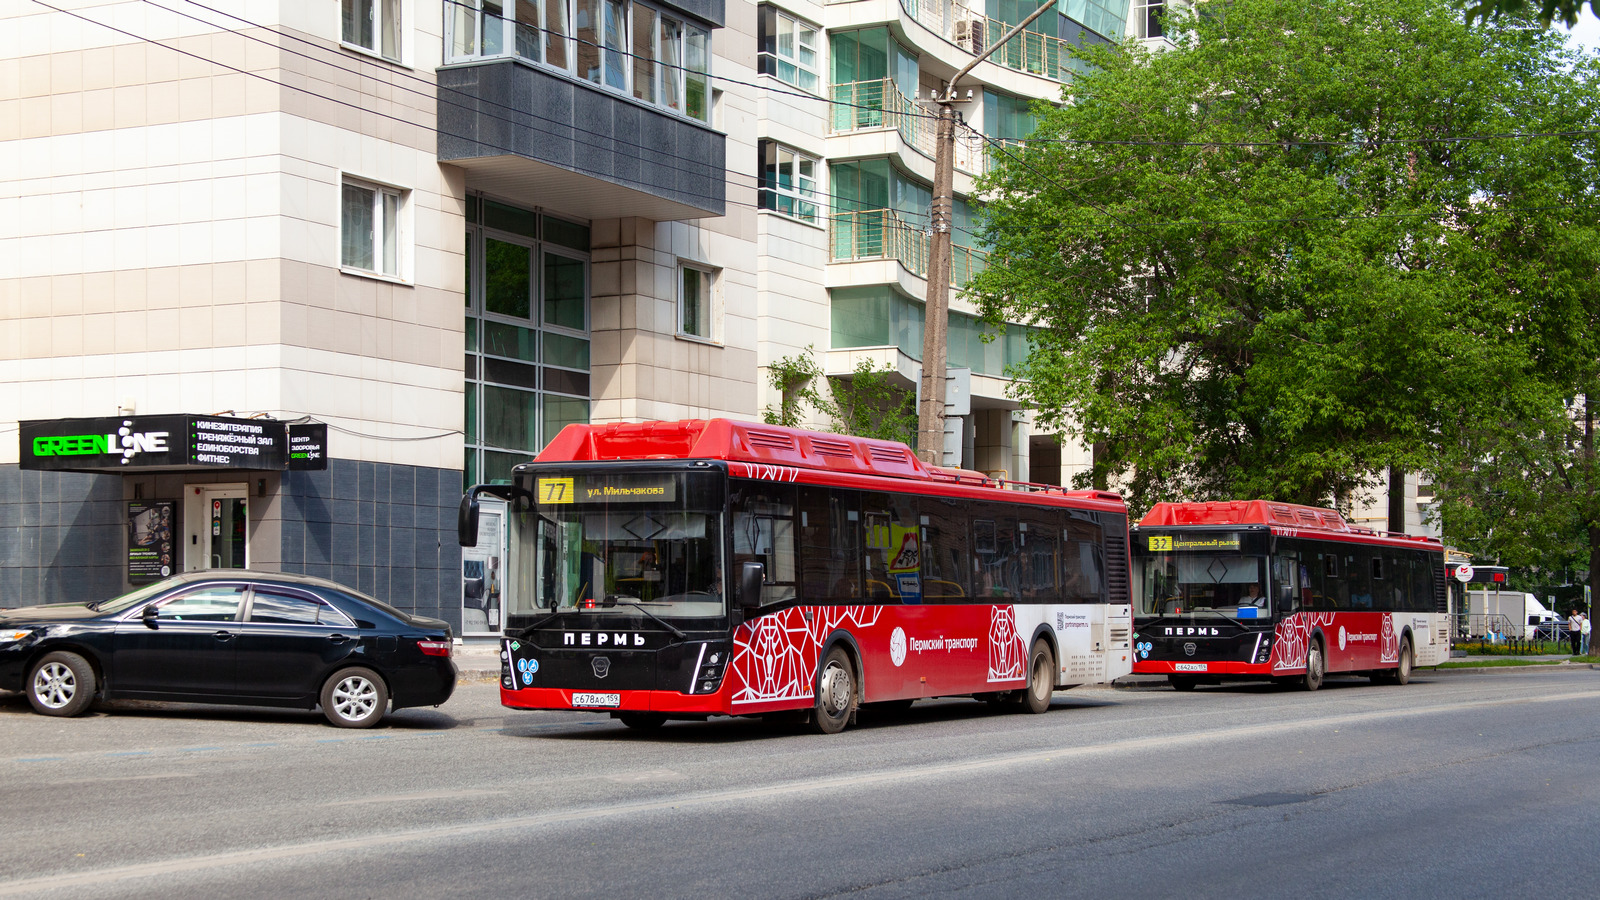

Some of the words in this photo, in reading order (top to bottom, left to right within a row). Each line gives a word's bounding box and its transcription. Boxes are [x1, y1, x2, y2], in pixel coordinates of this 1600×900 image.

[196, 420, 263, 434] КИНЕЗИТЕРАПИЯ
[197, 432, 256, 445] ТРЕНАЖЁРНЫЙ
[257, 437, 274, 446] ЗАЛ
[196, 443, 260, 456] ЕДИНОБОРСТВА
[197, 454, 230, 464] ФИТНЕС
[545, 482, 567, 501] 77
[587, 487, 602, 498] ул.
[603, 486, 665, 496] Мильчакова
[1152, 538, 1167, 550] 32
[1173, 539, 1218, 548] Центральный
[1165, 627, 1219, 636] ПЕРМЬ
[564, 632, 645, 646] ПЕРМЬ
[909, 635, 944, 655] Пермский
[944, 638, 978, 653] транспорт
